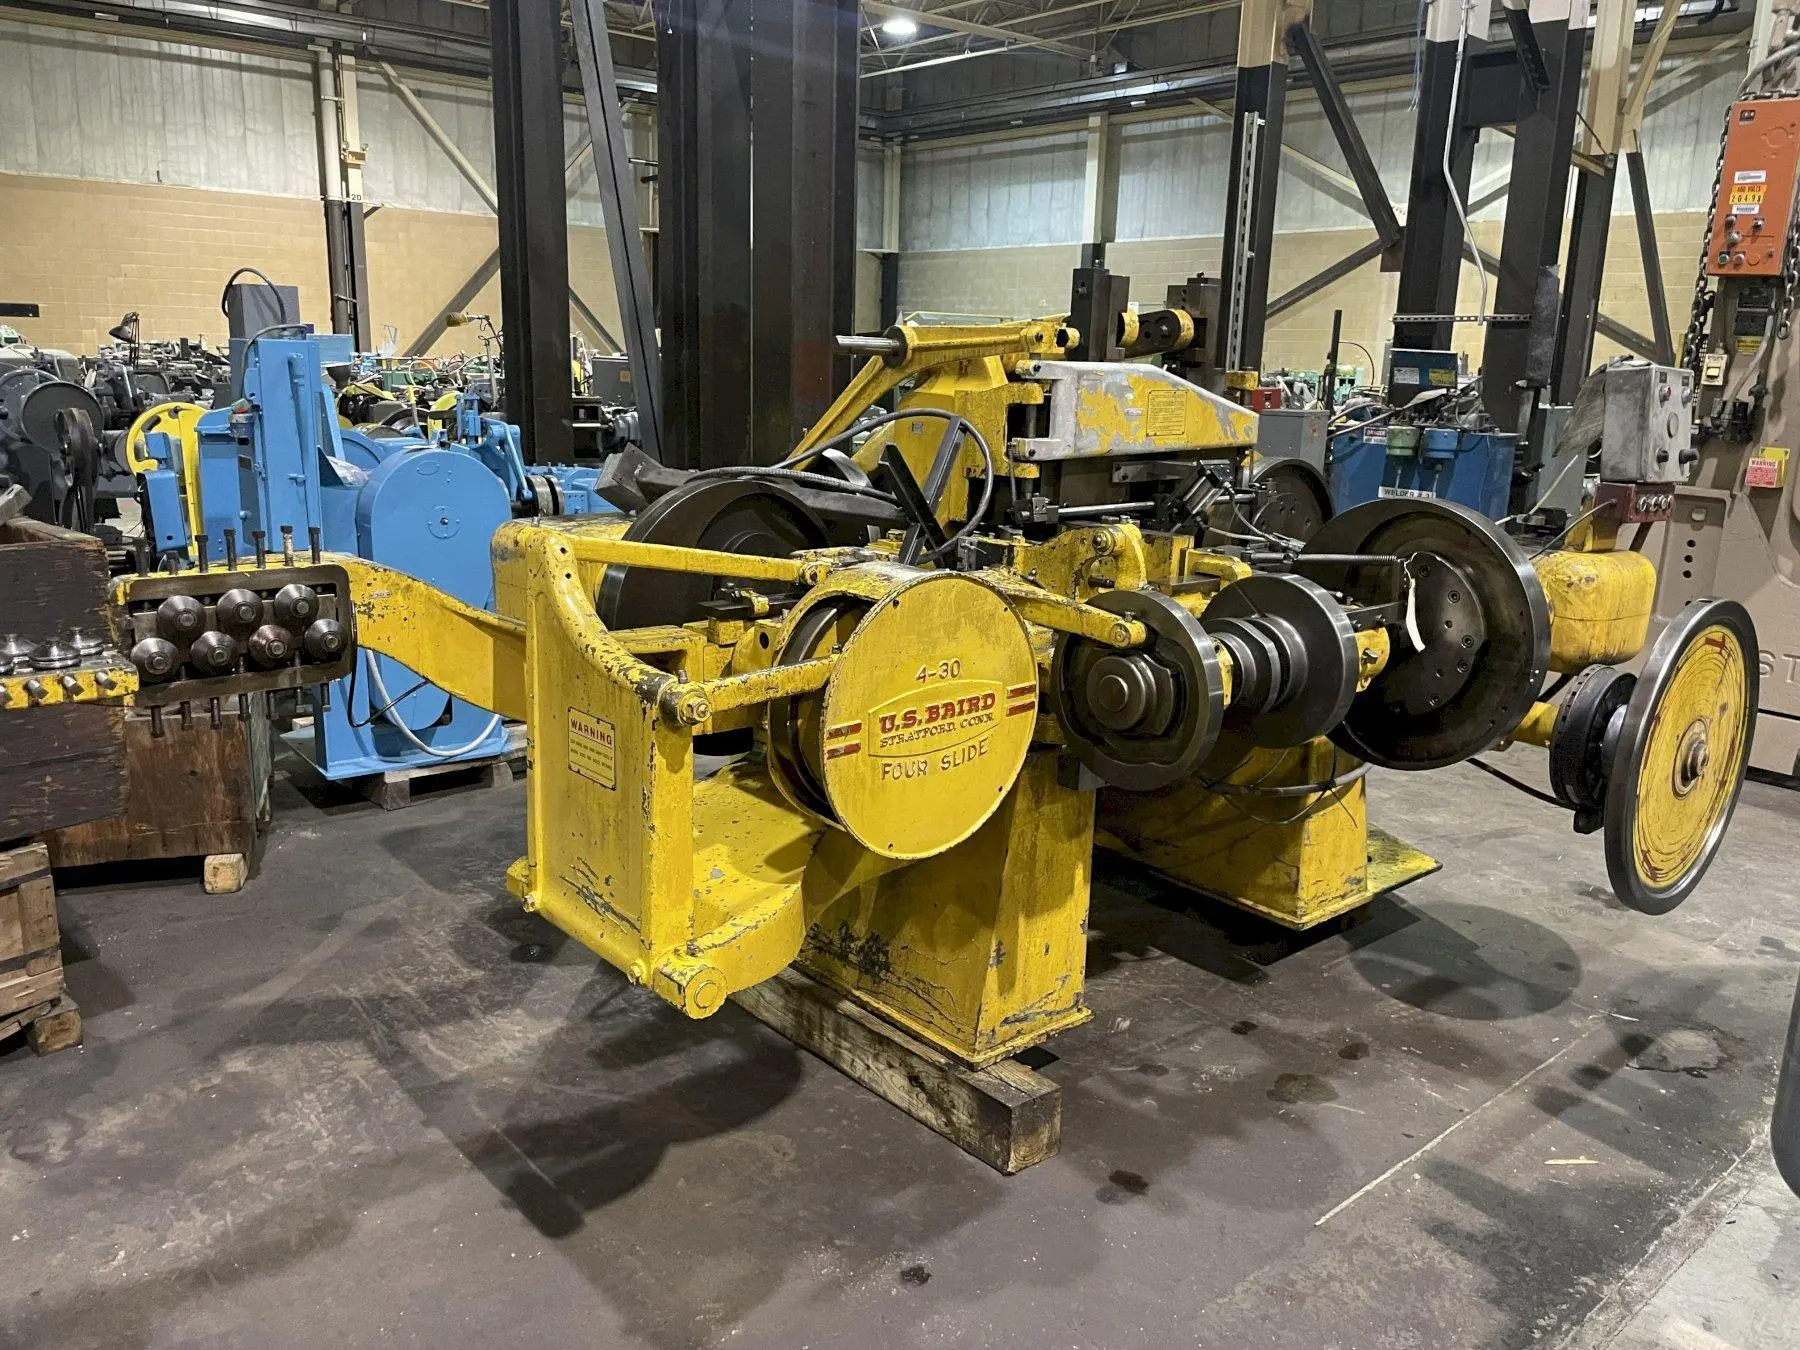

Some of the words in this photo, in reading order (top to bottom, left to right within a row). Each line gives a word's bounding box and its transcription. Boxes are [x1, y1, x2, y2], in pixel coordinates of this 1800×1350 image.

[1384, 488, 1414, 498] WELDER
[916, 658, 961, 684] 4-30
[570, 718, 613, 746] WARNING
[882, 759, 929, 781] FOUR
[940, 737, 990, 771] SLIDE
